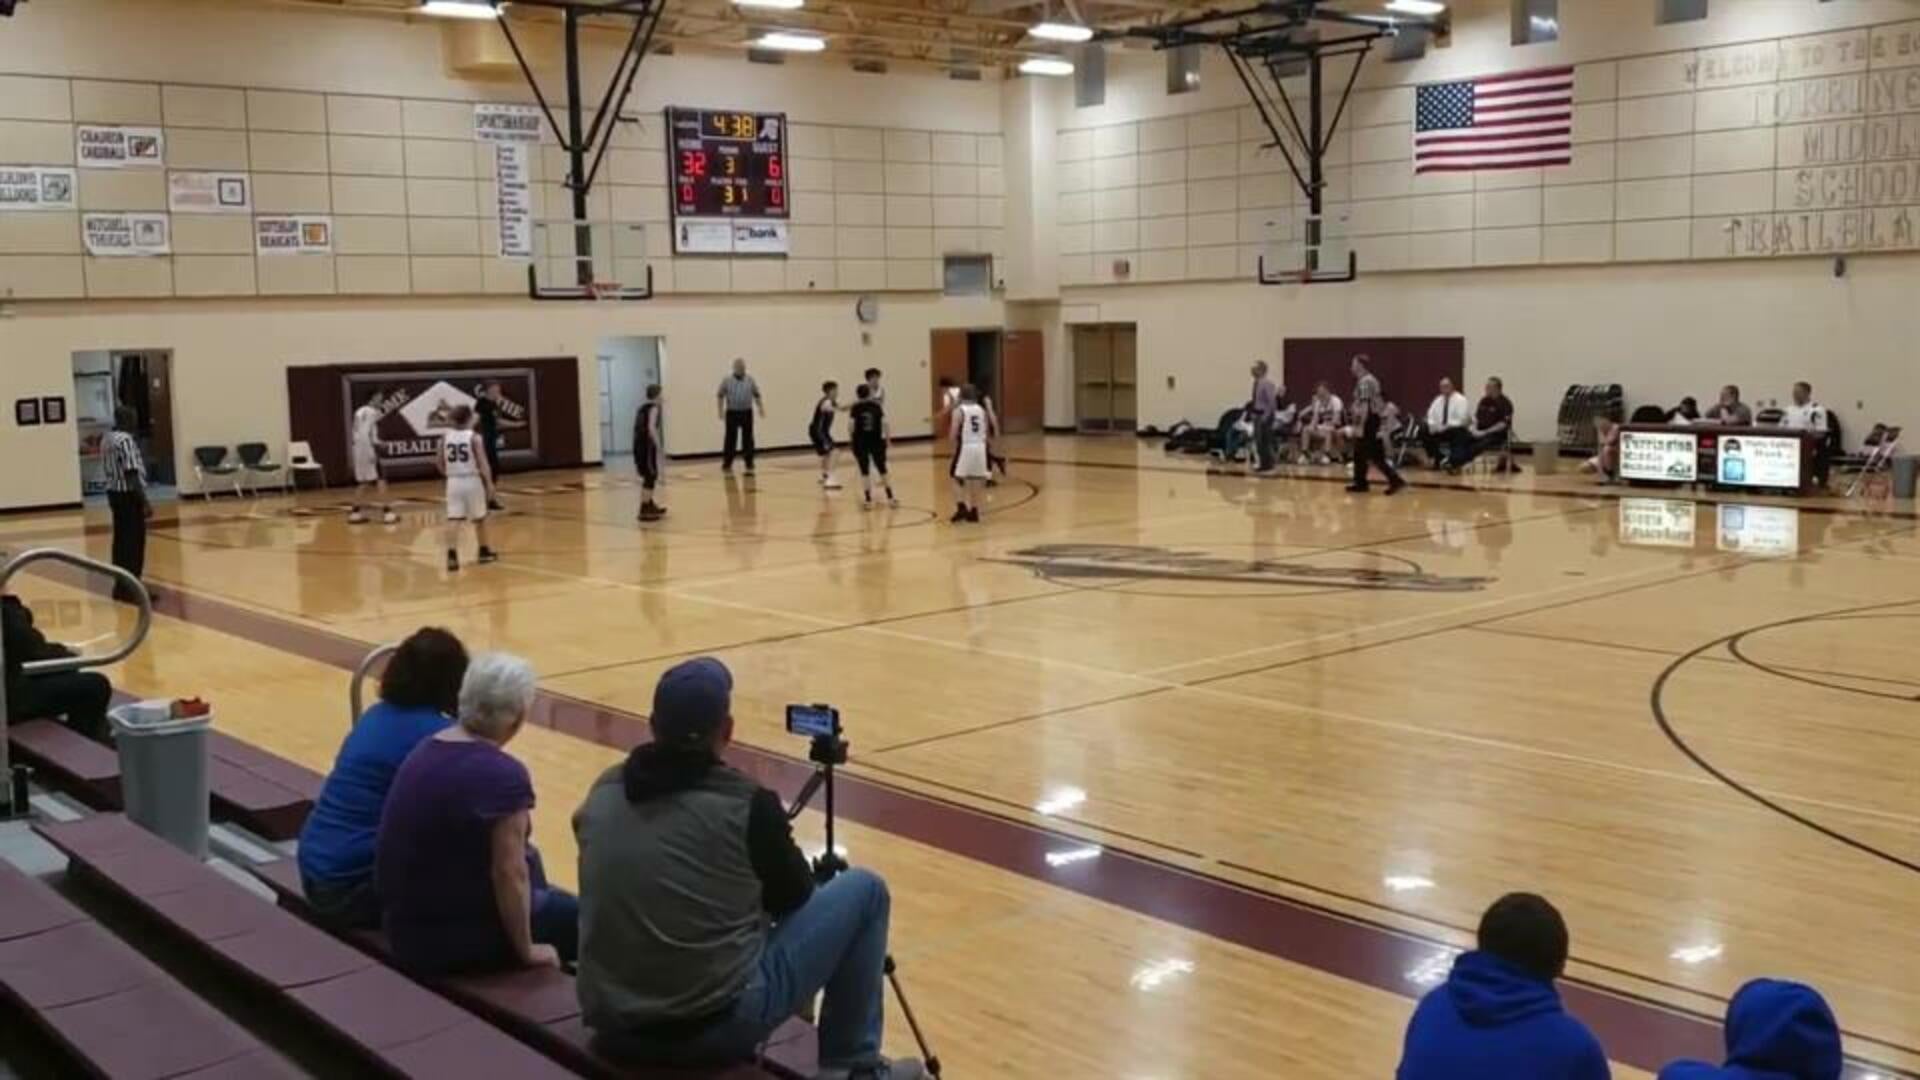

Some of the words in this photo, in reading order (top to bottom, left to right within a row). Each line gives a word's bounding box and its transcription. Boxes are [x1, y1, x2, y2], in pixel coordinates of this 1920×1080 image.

[682, 151, 706, 175] 32
[724, 156, 735, 174] 3
[768, 155, 780, 177] 6
[683, 184, 693, 202] 0
[724, 185, 734, 203] 3
[971, 415, 980, 433] 5
[447, 443, 469, 463] 35
